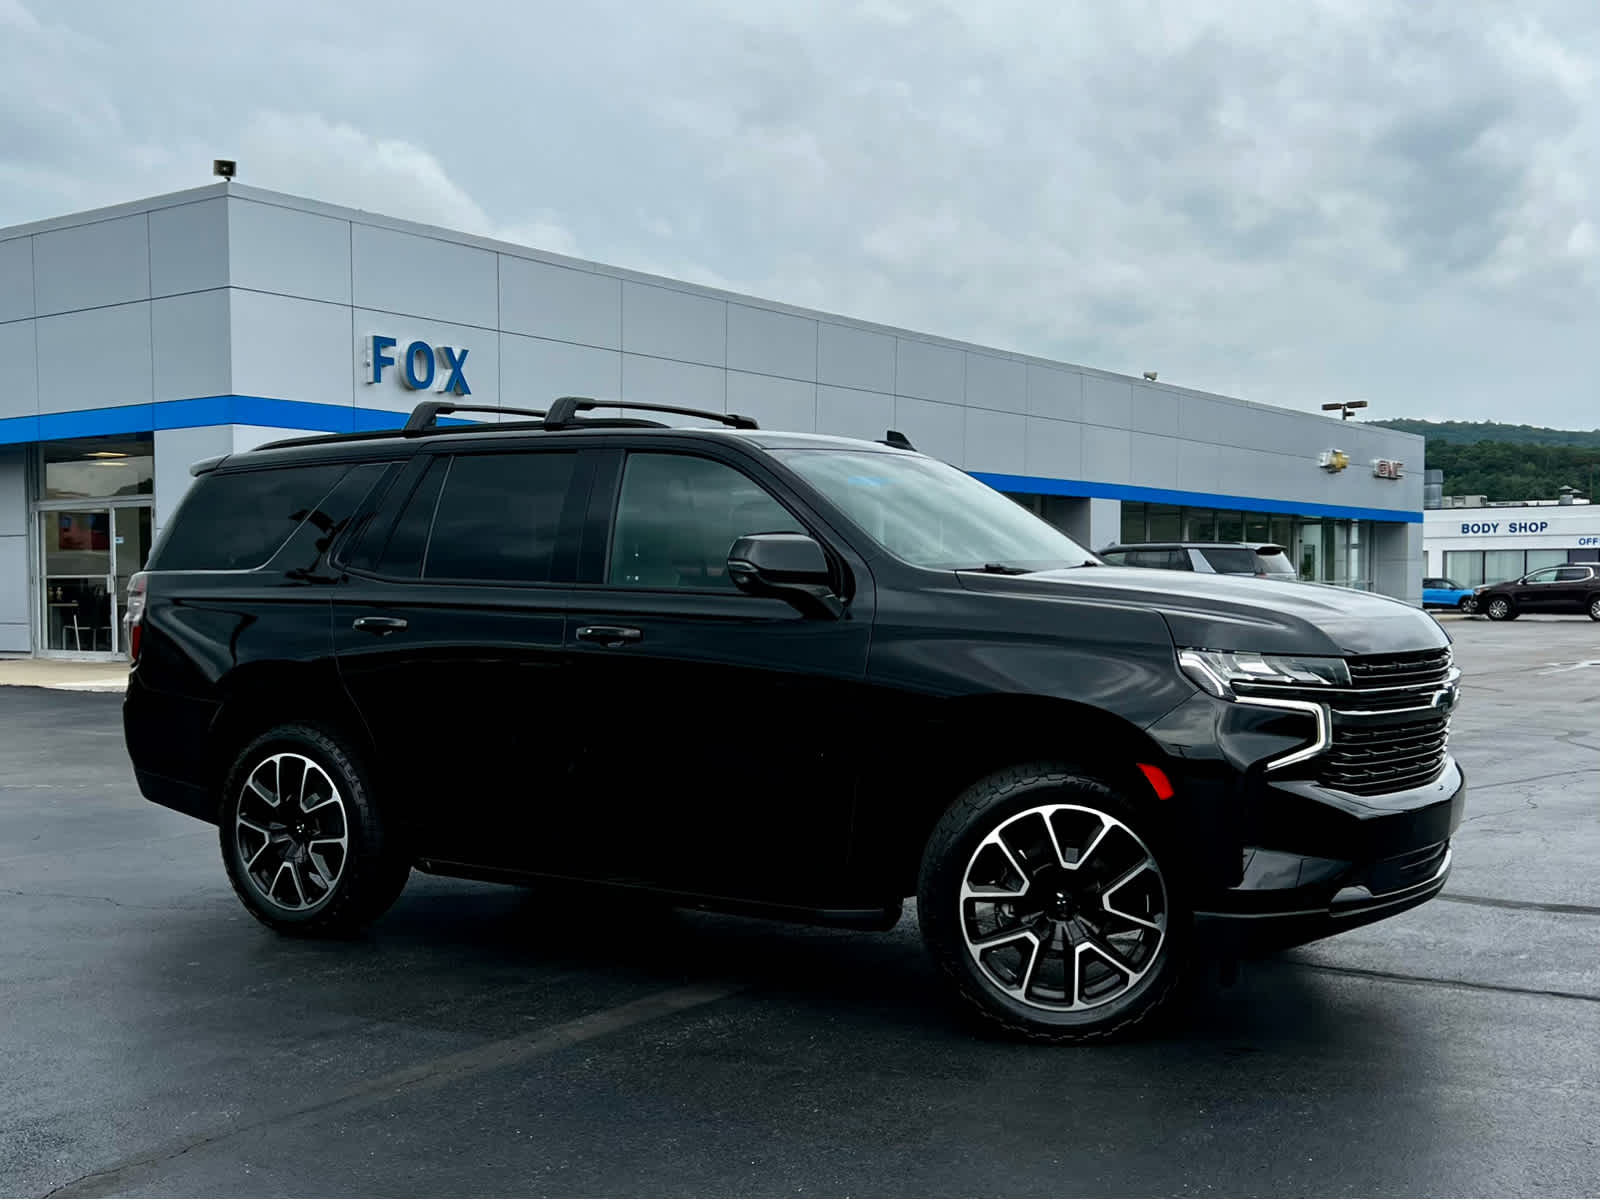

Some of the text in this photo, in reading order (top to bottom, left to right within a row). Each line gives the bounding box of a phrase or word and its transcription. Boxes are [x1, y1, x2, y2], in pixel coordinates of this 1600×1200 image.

[369, 334, 472, 396] FOX
[1461, 521, 1549, 535] BODY SHOP
